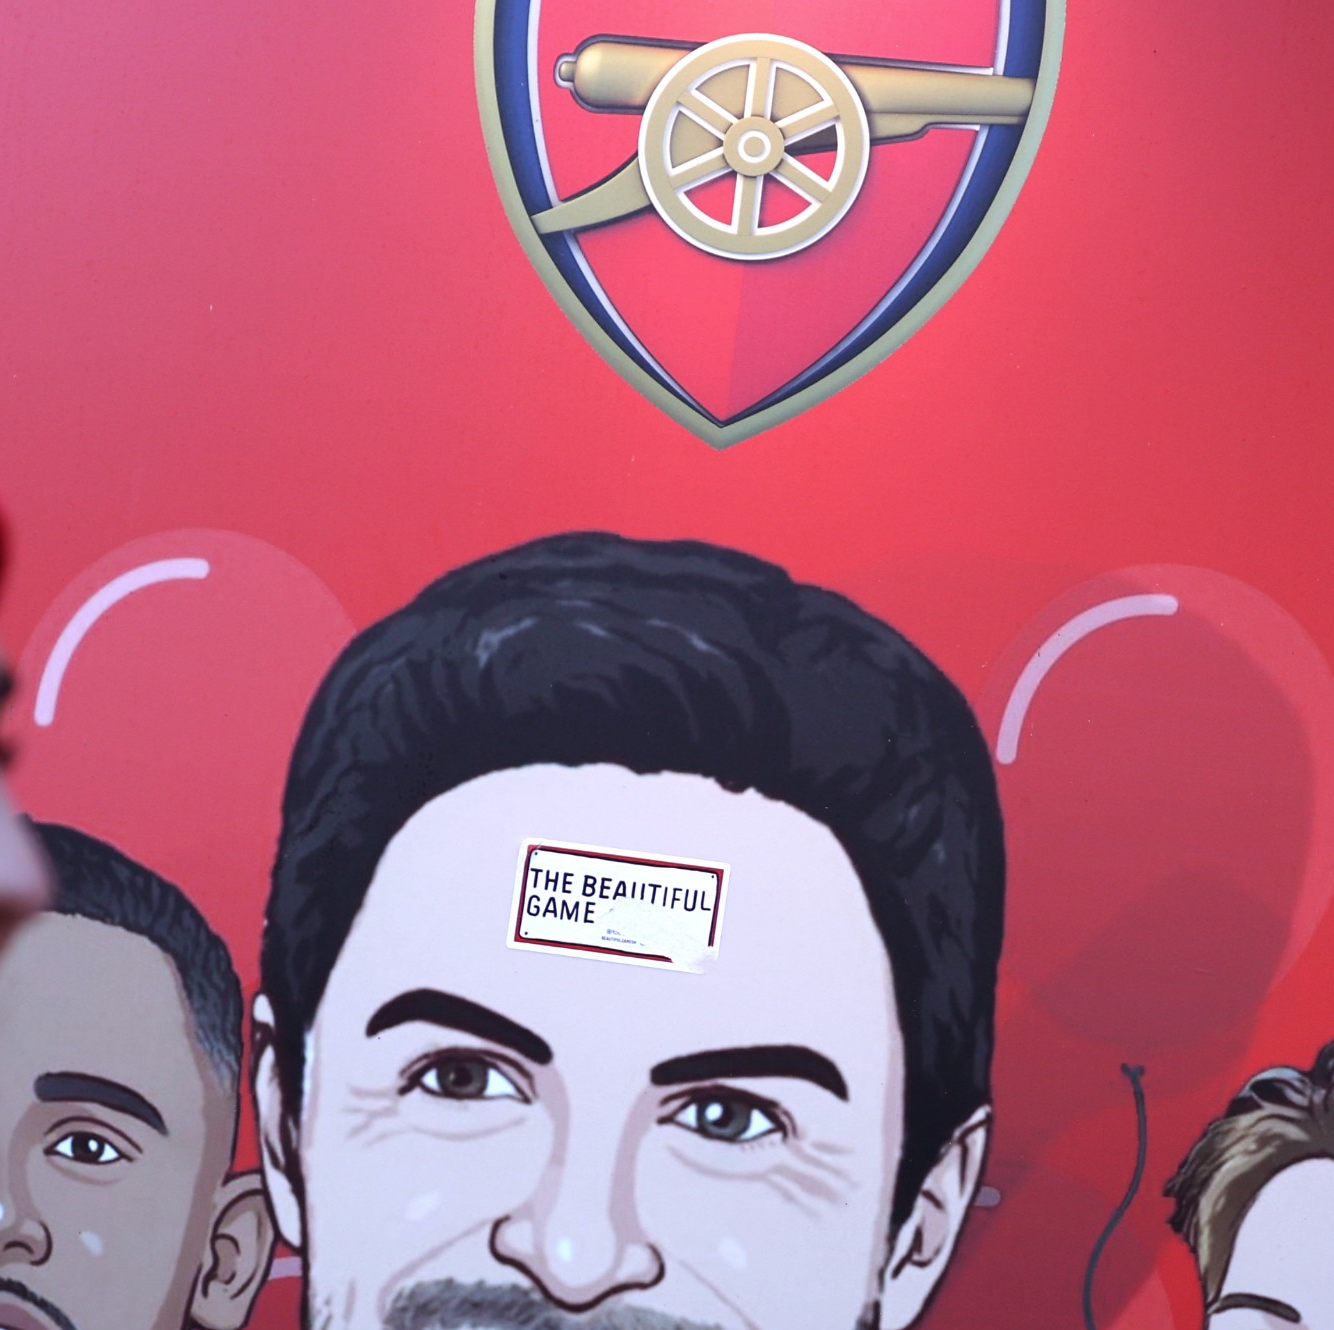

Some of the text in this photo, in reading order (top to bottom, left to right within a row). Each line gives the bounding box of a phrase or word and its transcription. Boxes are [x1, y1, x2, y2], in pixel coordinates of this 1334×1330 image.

[530, 868, 711, 912] THE BEAUTIFUL
[526, 894, 596, 923] GAME
